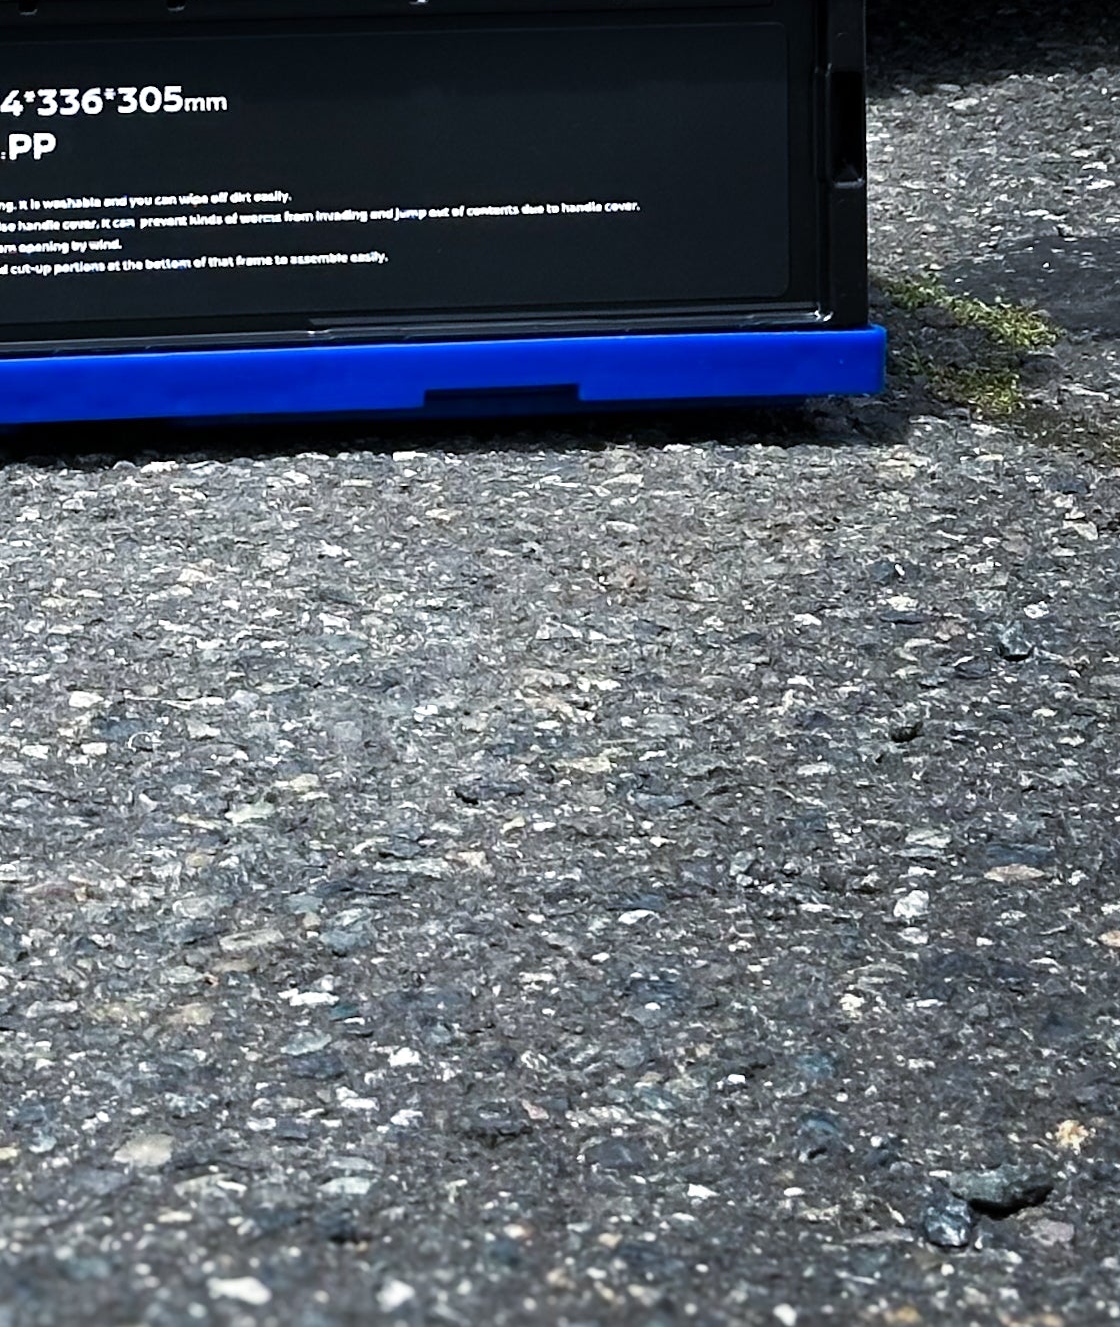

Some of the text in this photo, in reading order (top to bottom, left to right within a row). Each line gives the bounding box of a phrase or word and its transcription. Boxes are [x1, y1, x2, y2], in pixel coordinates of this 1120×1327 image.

[9, 133, 56, 160] PP
[18, 199, 28, 210] It
[30, 198, 40, 210] is
[42, 196, 101, 209] washable
[103, 195, 127, 207] and
[128, 196, 152, 208] you
[154, 195, 177, 205] can
[178, 192, 208, 207] wipe
[210, 191, 228, 204] off
[229, 191, 251, 203] dirt
[253, 190, 291, 203] easily.
[17, 219, 60, 231] handle
[62, 219, 99, 230] cover.
[101, 218, 110, 229] It
[112, 218, 135, 228] can
[140, 215, 187, 229] prevent
[189, 213, 222, 225] kinds
[224, 211, 237, 224] of
[284, 210, 313, 222] from
[315, 208, 367, 222] invading
[369, 207, 393, 219] and
[393, 207, 426, 221] jump
[451, 204, 464, 217] of
[466, 204, 519, 216] contents
[521, 203, 544, 214] due
[546, 203, 559, 213] to
[561, 200, 602, 213] handle
[604, 201, 640, 212] cover.
[18, 240, 69, 254] opening
[71, 240, 86, 253] by
[88, 238, 122, 250] wind.
[54, 260, 105, 275] portions
[107, 260, 120, 271] at
[122, 259, 142, 270] the
[145, 258, 191, 269] bottom
[193, 255, 206, 268] of
[208, 256, 234, 267] that
[235, 254, 272, 266] frame
[274, 255, 288, 265] to
[290, 252, 348, 264] assemble
[350, 250, 388, 263] easily.
